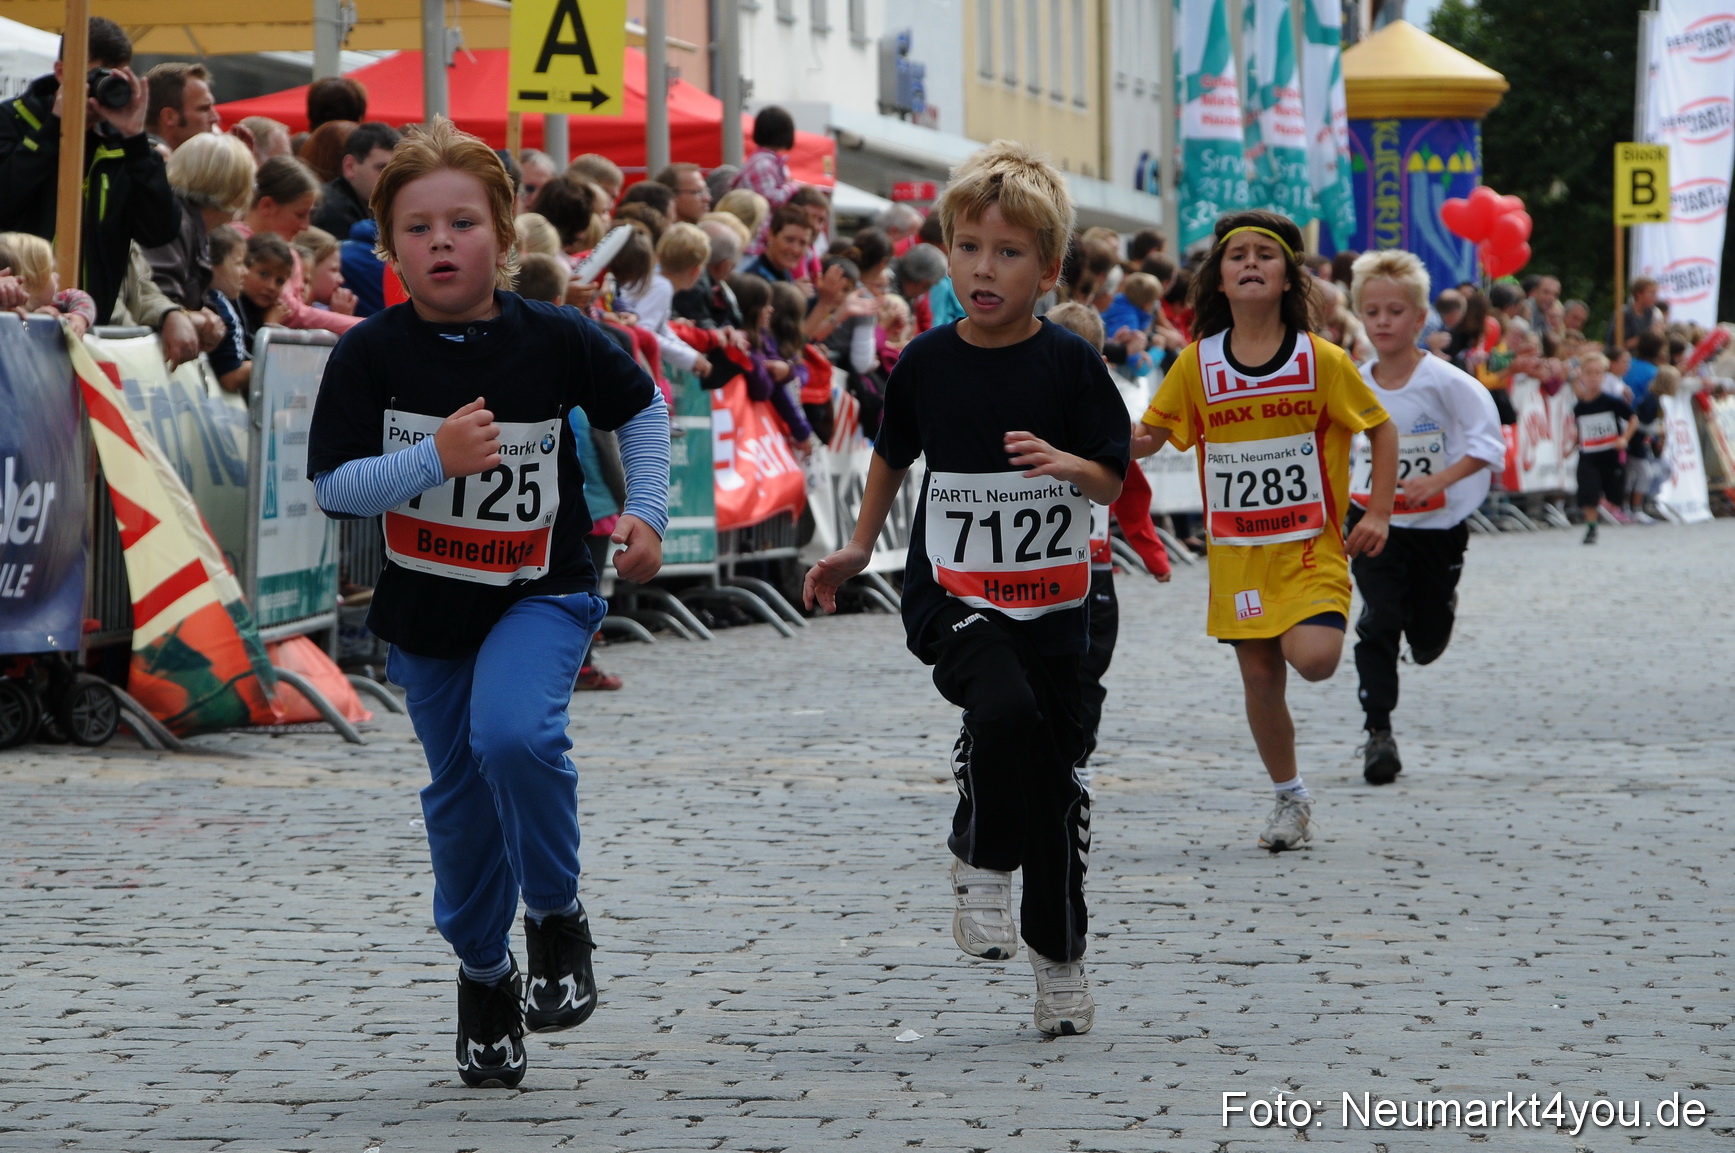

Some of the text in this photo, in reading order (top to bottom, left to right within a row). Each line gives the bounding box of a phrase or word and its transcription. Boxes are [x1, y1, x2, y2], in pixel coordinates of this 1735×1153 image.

[533, 0, 598, 75] A
[1632, 169, 1658, 205] B
[1208, 398, 1317, 428] MAX BÖGL
[1208, 448, 1297, 464] PARTL Neumarkt
[930, 484, 1064, 503] PARTL Neumarkt
[1216, 464, 1308, 508] 7283
[946, 504, 1072, 563] 7122
[1235, 512, 1296, 533] Samuel
[417, 528, 525, 565] Benedikt
[984, 577, 1046, 602] Henri
